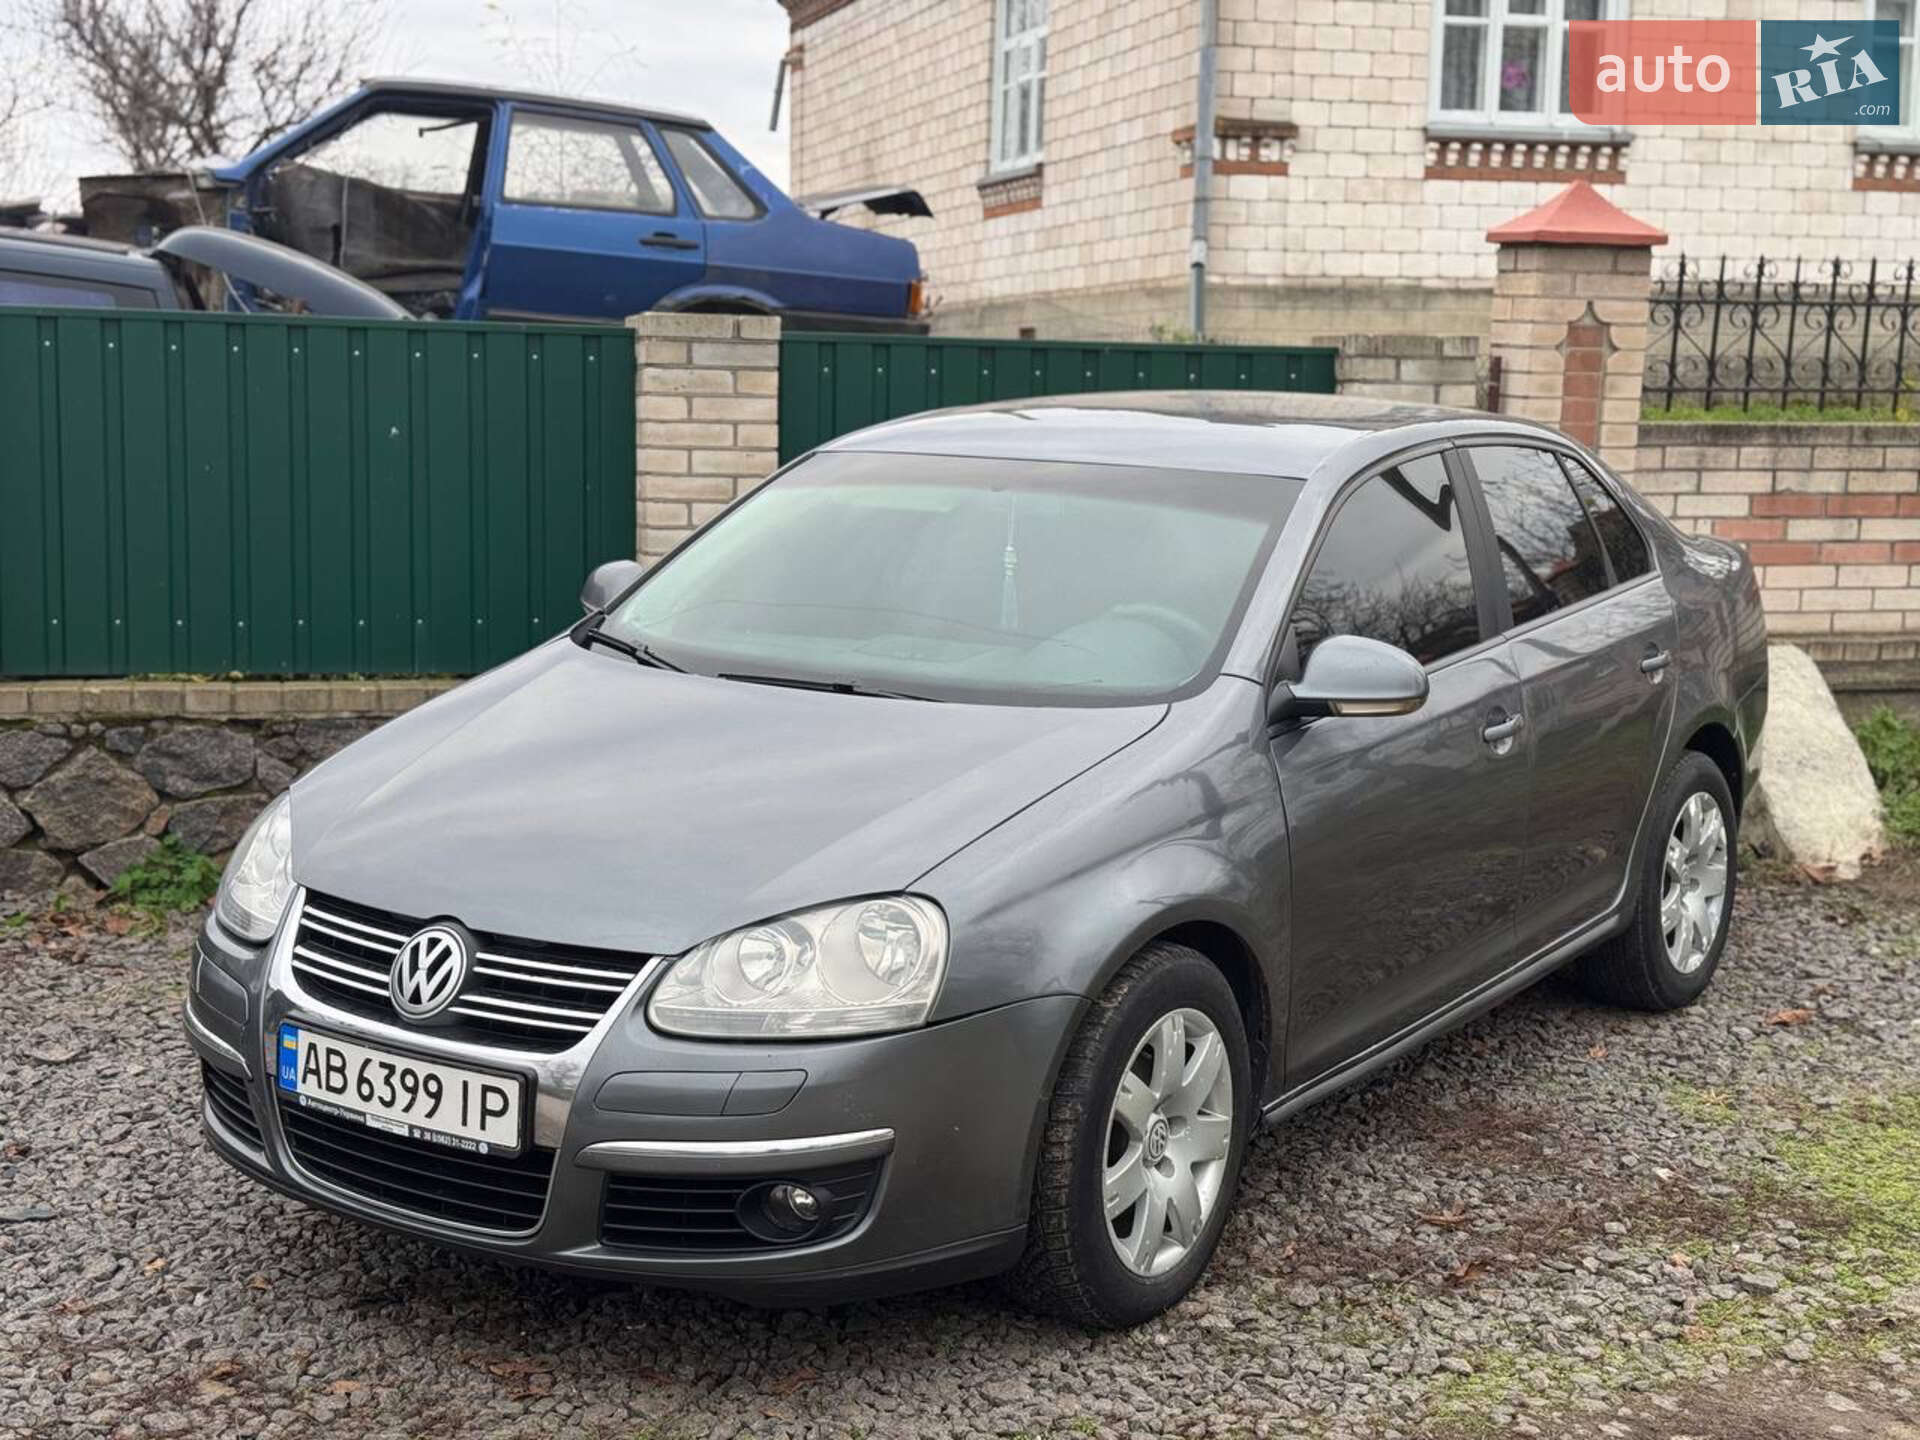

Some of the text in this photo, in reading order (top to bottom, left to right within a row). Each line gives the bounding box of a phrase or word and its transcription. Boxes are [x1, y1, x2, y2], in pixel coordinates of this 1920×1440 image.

[282, 1065, 296, 1081] UA
[301, 1042, 348, 1095] AB
[356, 1057, 443, 1119] 6399
[461, 1080, 510, 1131] IP
